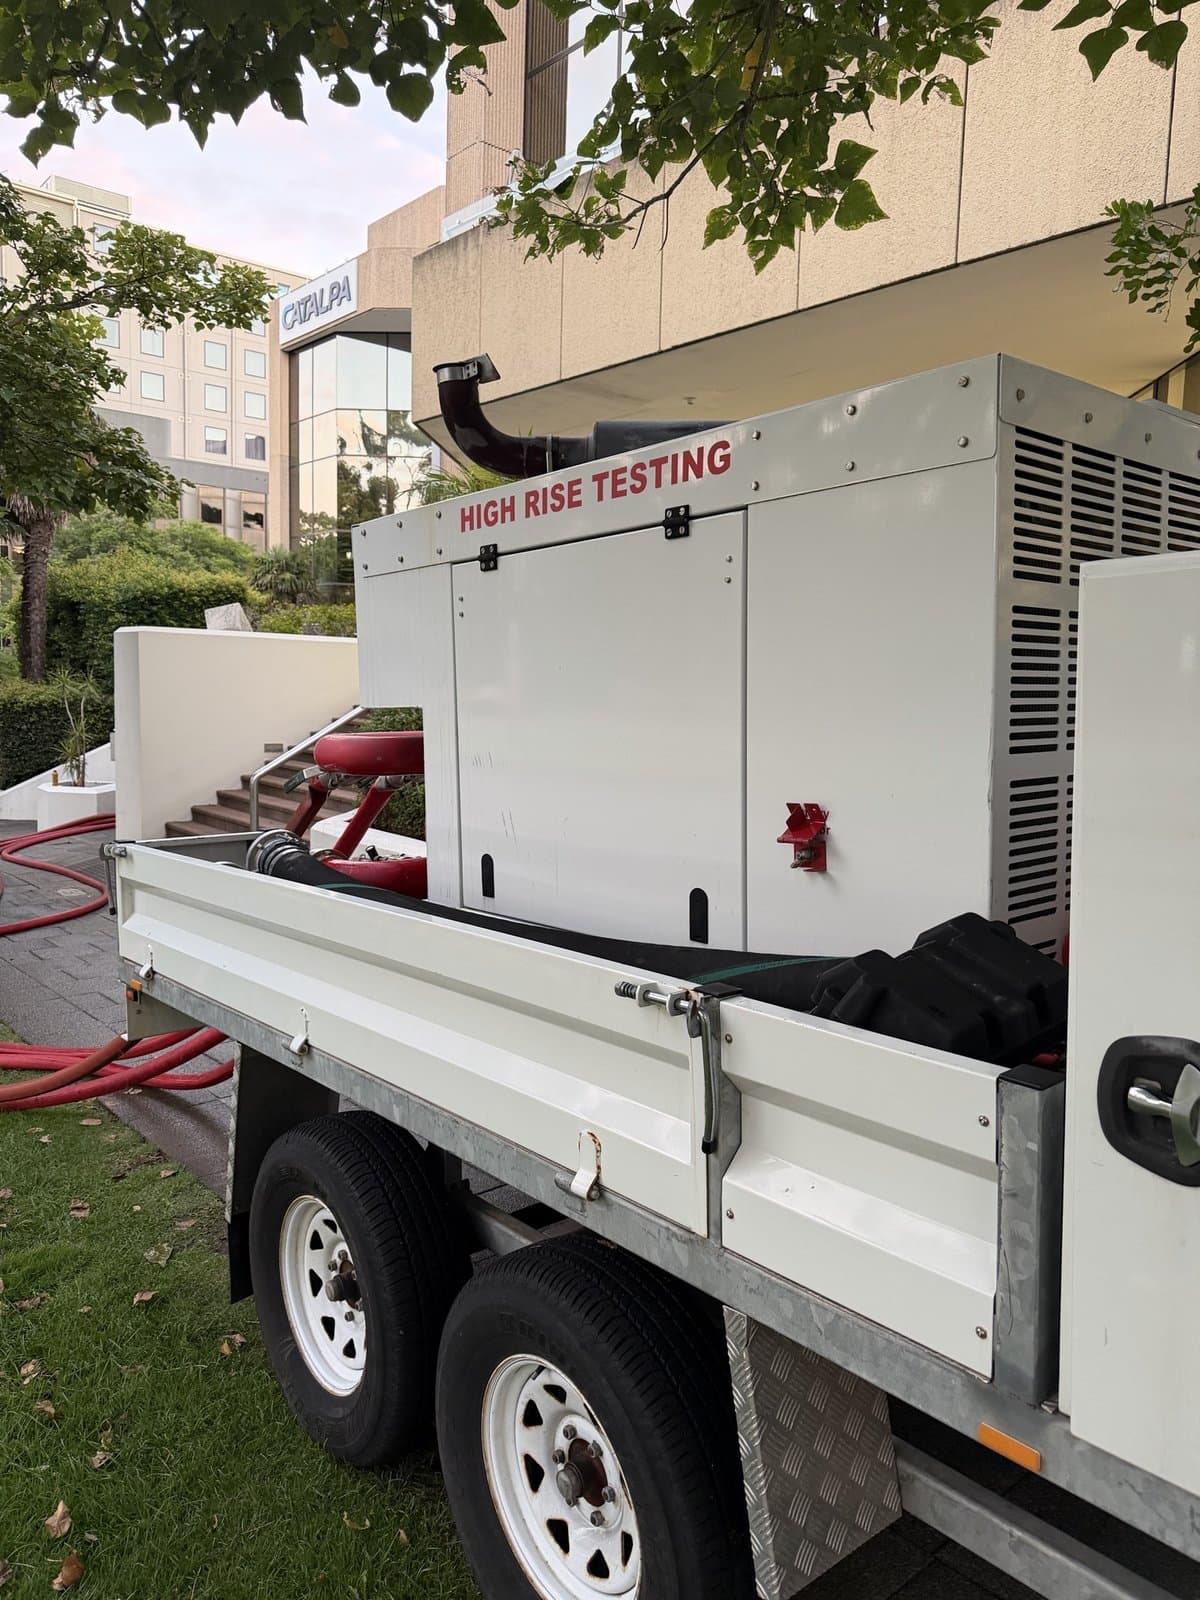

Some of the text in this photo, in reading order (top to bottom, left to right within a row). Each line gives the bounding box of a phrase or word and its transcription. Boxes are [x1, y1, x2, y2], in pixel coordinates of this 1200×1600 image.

[281, 275, 352, 330] CATALPA
[460, 440, 732, 533] HIGH RISE TESTING
